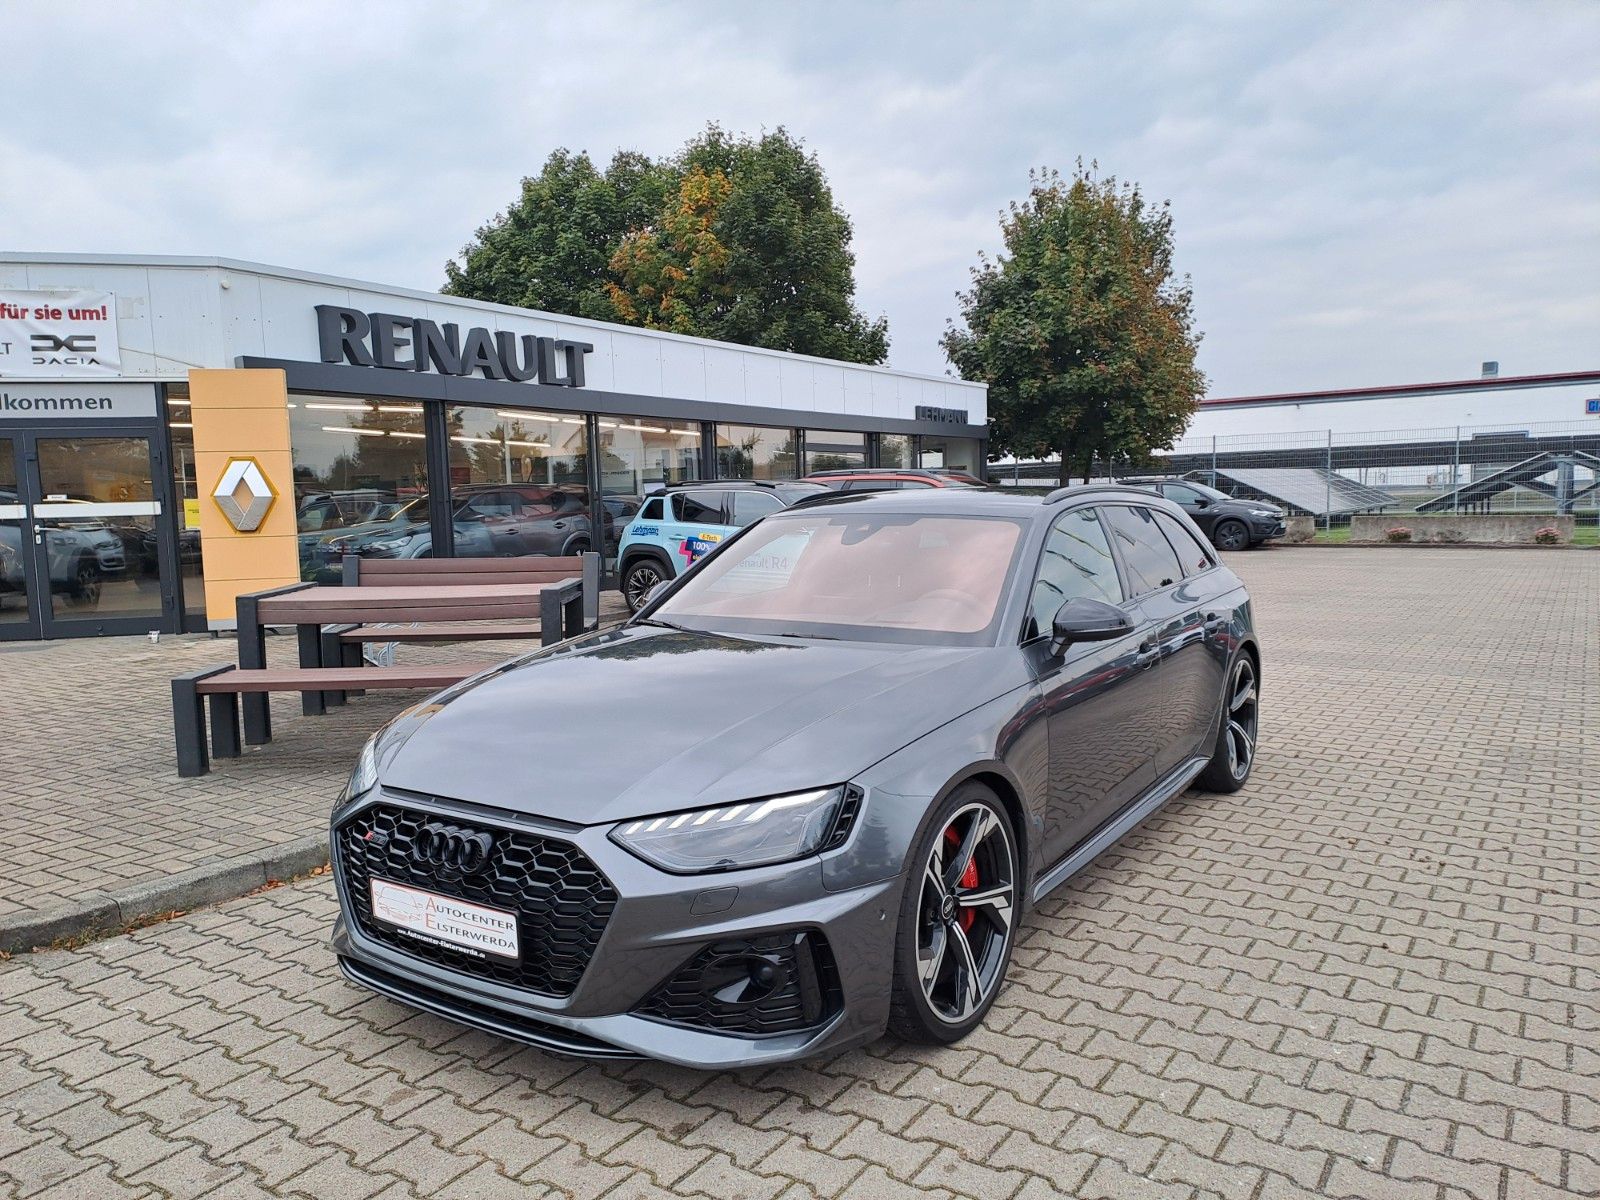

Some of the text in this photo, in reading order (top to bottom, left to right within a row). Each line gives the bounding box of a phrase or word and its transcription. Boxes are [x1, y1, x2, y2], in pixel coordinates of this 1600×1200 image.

[0, 303, 107, 320] für sie um!
[314, 304, 594, 388] RENAULT
[32, 357, 101, 365] DACIA
[915, 405, 968, 424] LEHMANN
[771, 556, 788, 569] R4
[426, 896, 515, 930] AUTOCENTER
[426, 912, 516, 950] ELSTERWERDA
